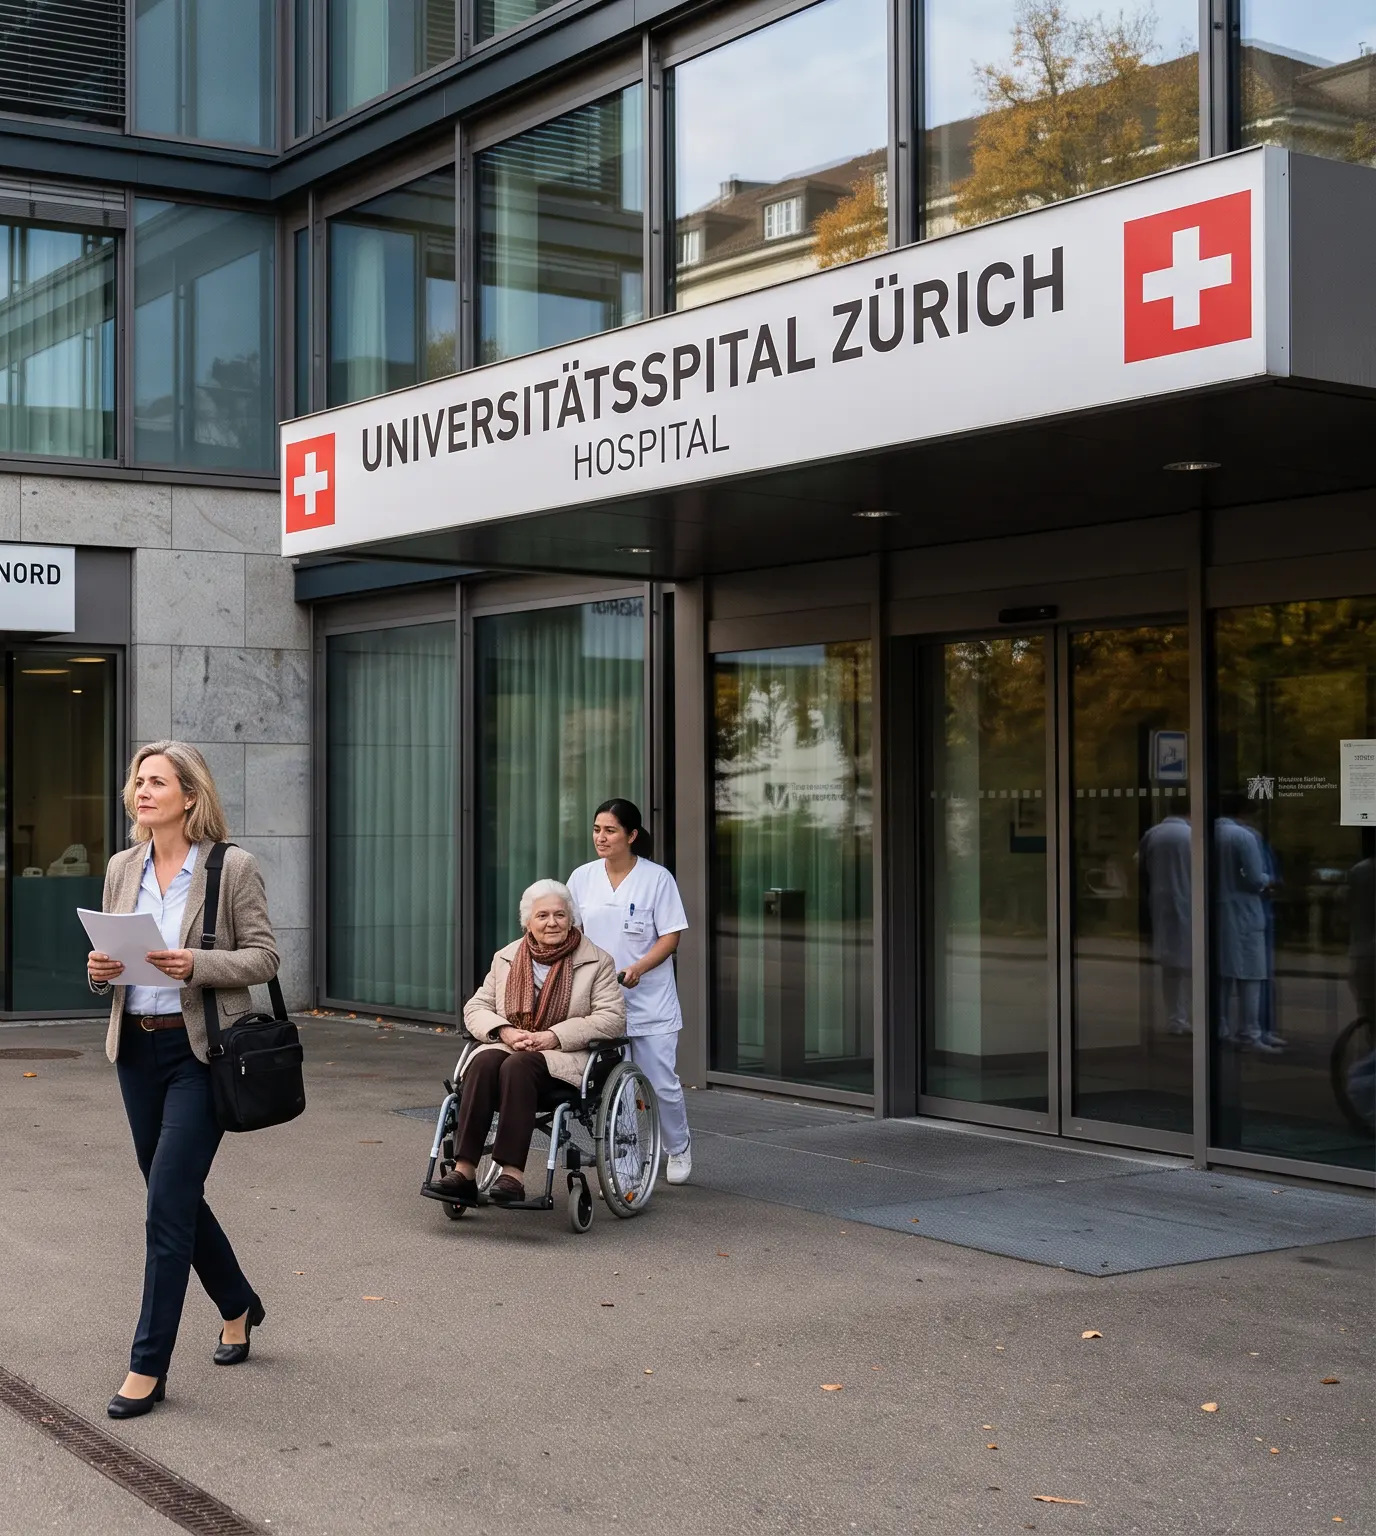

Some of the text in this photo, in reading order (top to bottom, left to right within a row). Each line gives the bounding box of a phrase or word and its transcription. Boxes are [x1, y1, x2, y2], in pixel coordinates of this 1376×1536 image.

[362, 245, 1064, 472] UNIVERSITÄTSSPITAL ZÜRICH
[574, 414, 730, 481] HOSPITAL
